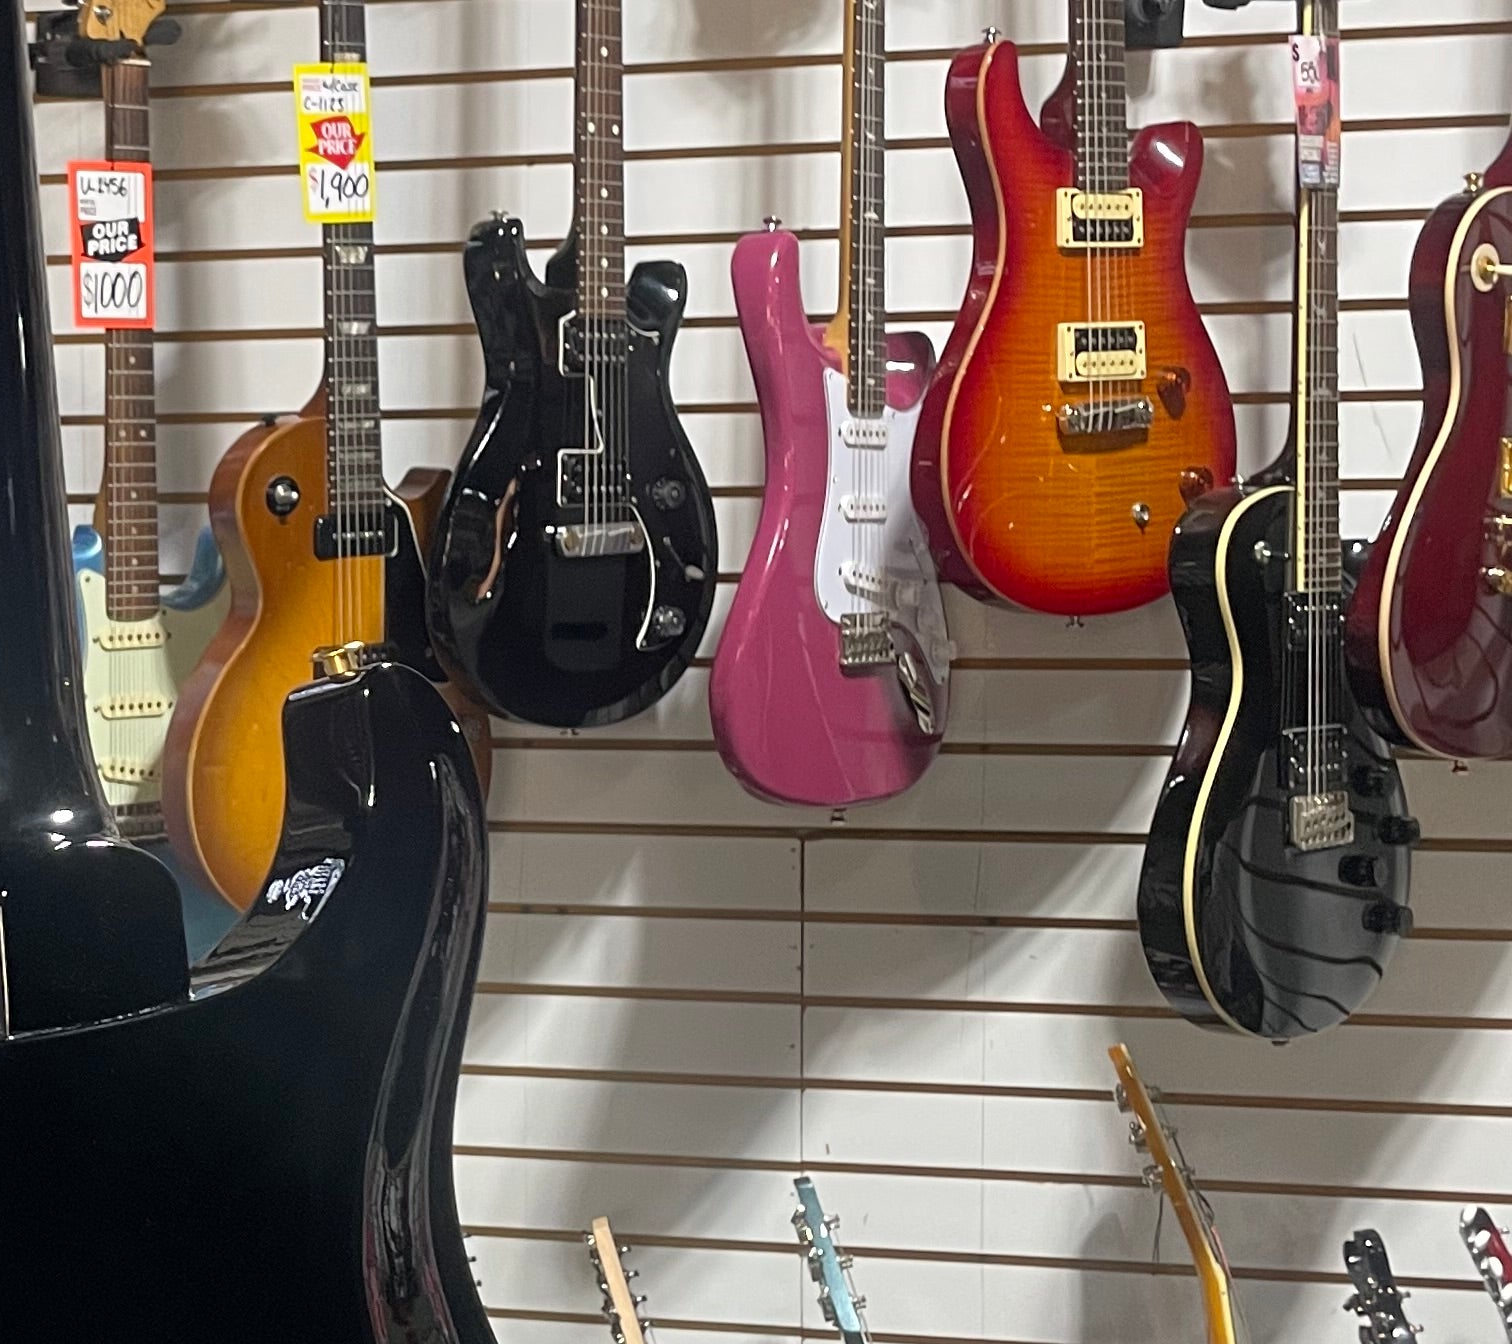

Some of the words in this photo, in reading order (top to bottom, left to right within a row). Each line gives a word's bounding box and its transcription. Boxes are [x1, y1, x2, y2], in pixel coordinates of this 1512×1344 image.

[320, 122, 351, 139] OUR
[318, 138, 357, 155] PRICE
[92, 221, 129, 240] OUR
[88, 235, 138, 257] PRICE
[82, 271, 143, 314] $1000
